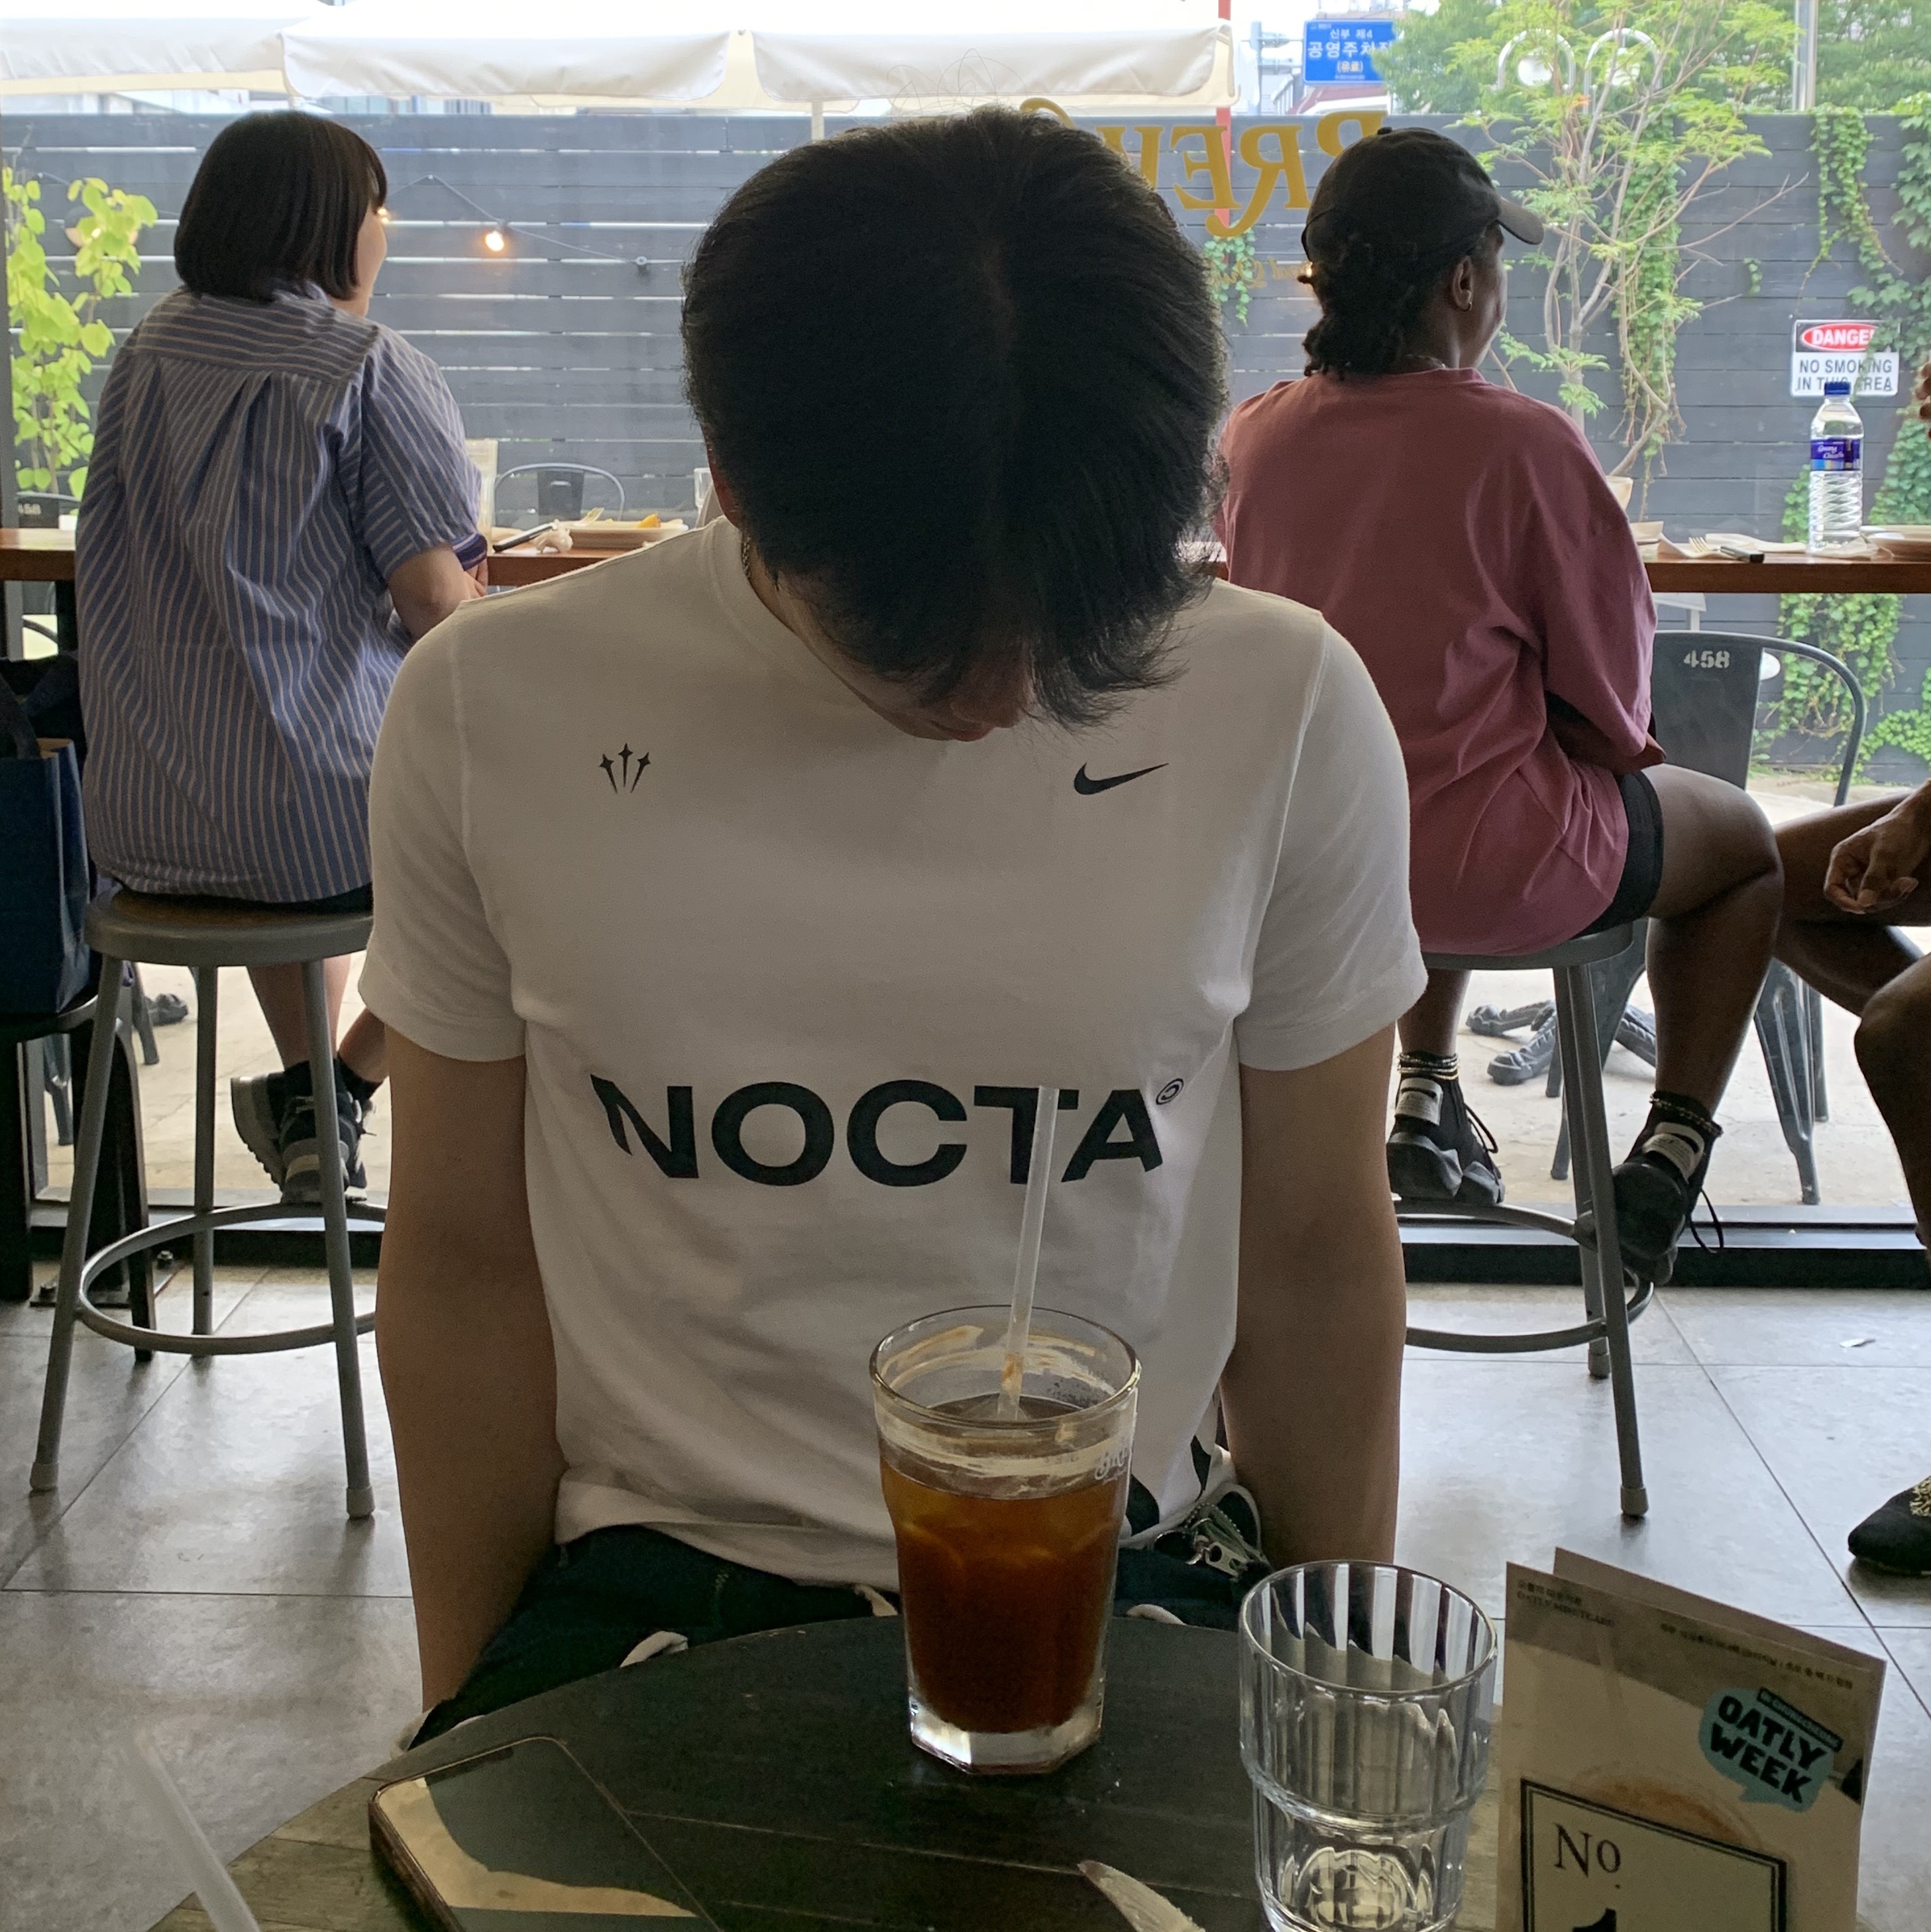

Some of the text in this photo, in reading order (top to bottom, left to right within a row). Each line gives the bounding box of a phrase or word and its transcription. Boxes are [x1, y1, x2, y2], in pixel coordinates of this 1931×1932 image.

[1330, 28, 1351, 39] 신부
[1800, 360, 1820, 373] NO
[1797, 376, 1812, 391] IN
[1683, 649, 1730, 668] 458
[590, 1073, 1164, 1187] NOCTA
[1718, 1695, 1828, 1770] OATLY
[1710, 1722, 1812, 1803] WEEK
